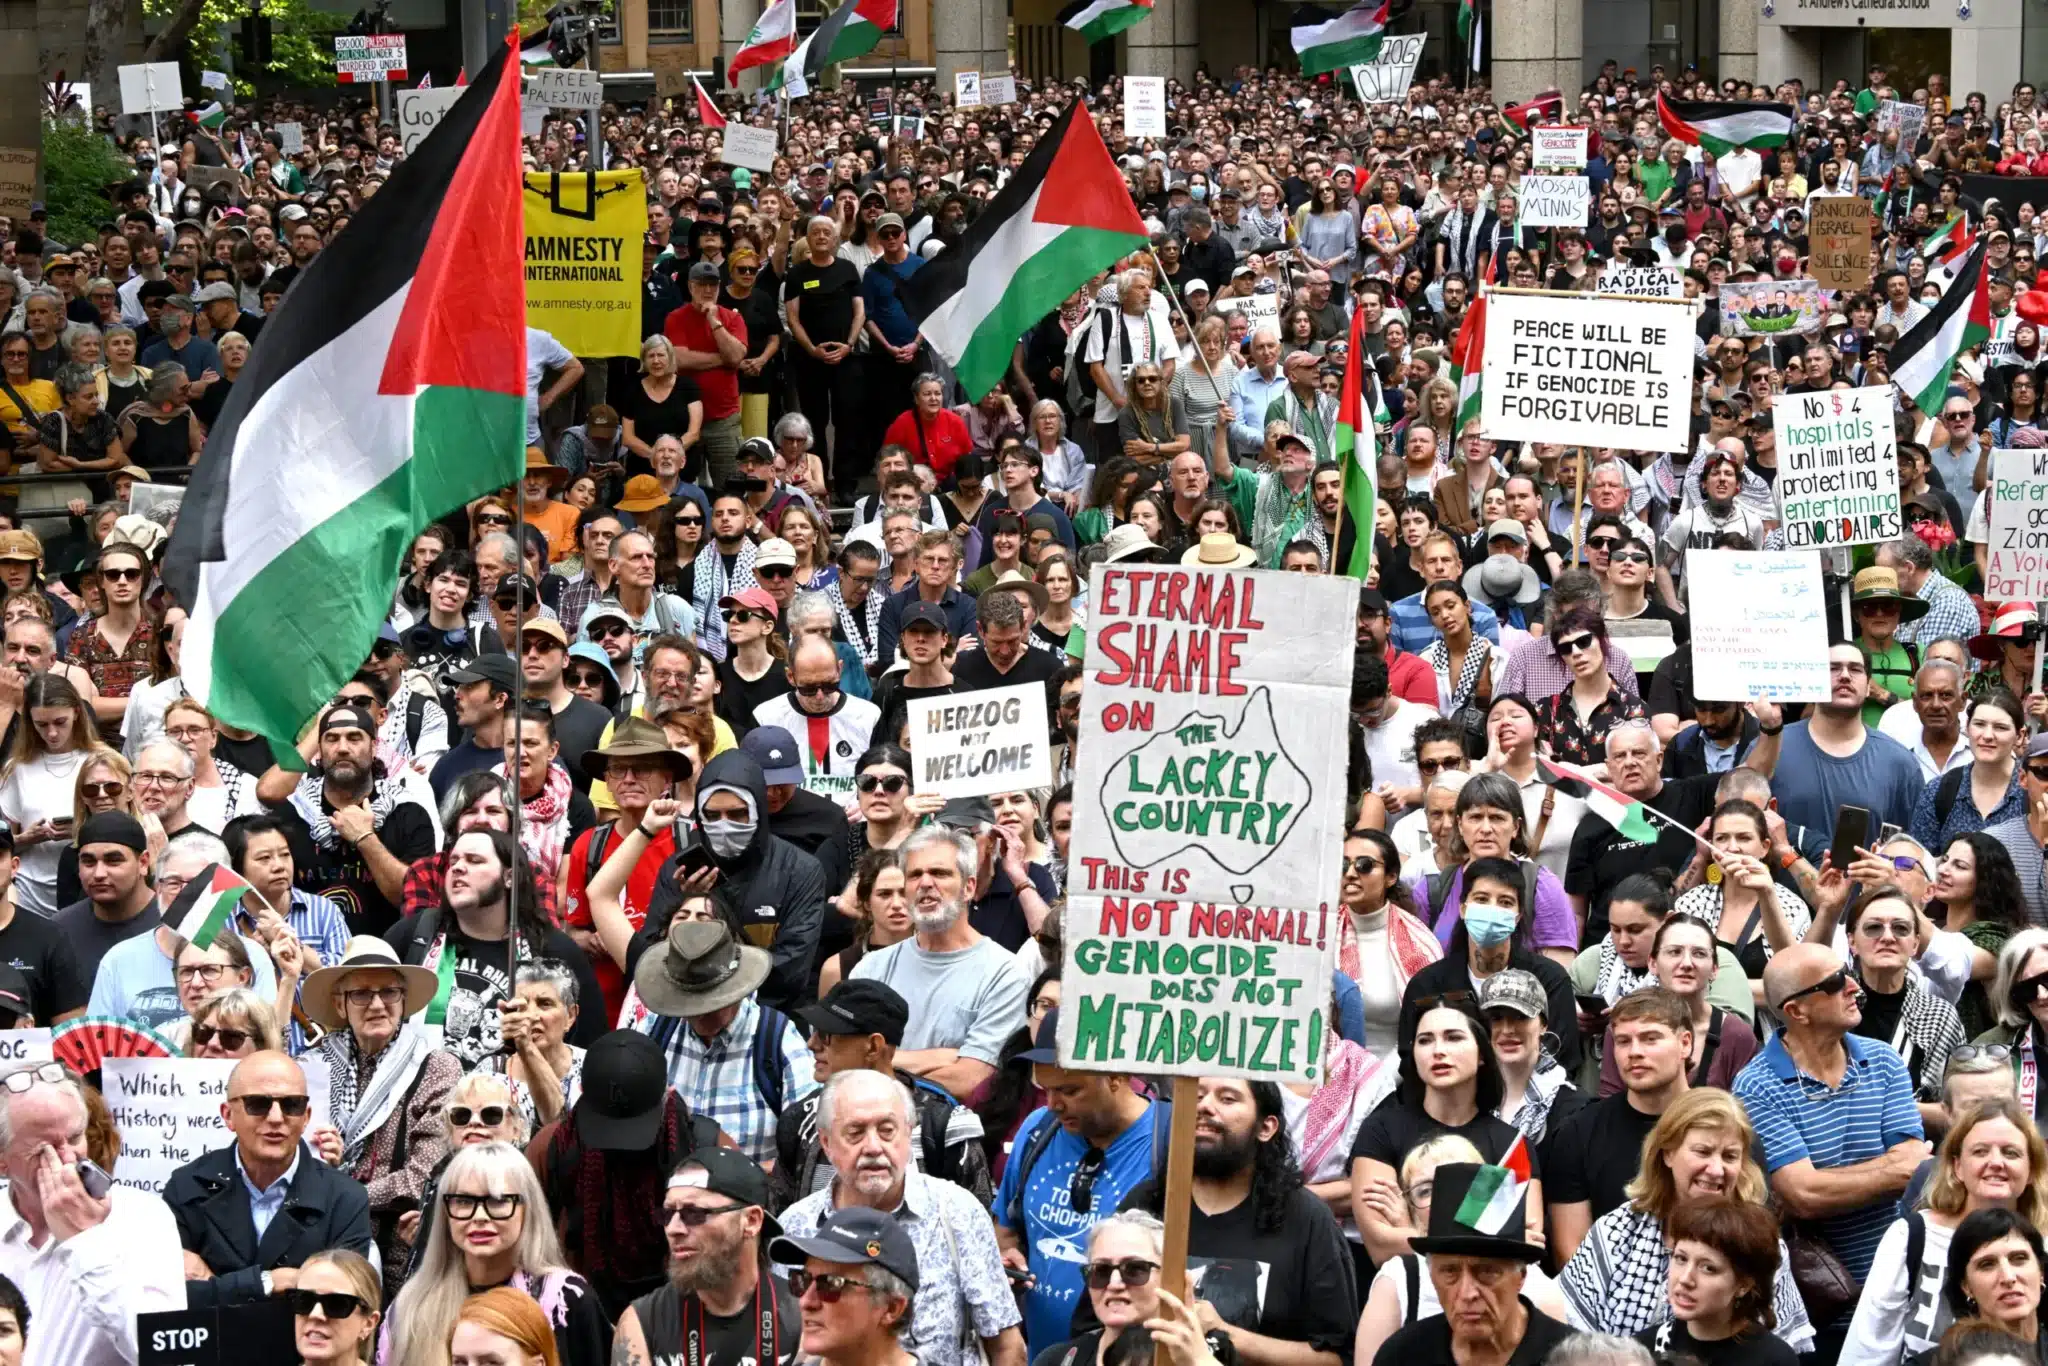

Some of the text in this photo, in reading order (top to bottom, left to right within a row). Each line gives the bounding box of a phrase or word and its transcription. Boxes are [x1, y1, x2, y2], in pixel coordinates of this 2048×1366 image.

[339, 60, 403, 72] MURDERED UNDER
[370, 48, 393, 59] UNDER
[397, 48, 403, 57] 5
[354, 71, 386, 82] HERZOG
[543, 73, 588, 87] FREE
[1358, 66, 1412, 101] OUT
[529, 88, 600, 105] PALESTINE
[1542, 140, 1577, 149] GENOCIDE
[1523, 178, 1588, 198] MOSSAD
[1521, 198, 1583, 220] MINNS
[1813, 203, 1869, 217] SANCTION
[1817, 220, 1862, 236] ISRAEL
[525, 236, 624, 261] AMNESTY
[1827, 236, 1853, 249] NOT
[524, 266, 624, 281] INTERNATIONAL
[1814, 253, 1869, 269] SILENCE
[1599, 273, 1679, 289] RADICAL
[1831, 270, 1852, 282] US
[1625, 287, 1669, 296] OPPOSE
[1236, 300, 1256, 309] WAR
[1513, 319, 1666, 345] PEACE WILL BE
[1514, 344, 1662, 374] FICTIONAL
[1505, 372, 1668, 399] IF GENOCIDE IS
[1502, 395, 1668, 428] FORGIVABLE
[1803, 393, 1861, 419] No $ 4
[1787, 418, 1873, 446] hospitals
[1790, 441, 1893, 470] unlimited 4
[1783, 470, 1877, 499] protecting
[1785, 493, 1898, 520] entertaining
[1787, 512, 1900, 547] GENOCIDAIRES
[1990, 551, 2001, 572] A
[1100, 570, 1265, 631] ETERNAL
[1095, 621, 1248, 696] SHAME
[927, 697, 1021, 734] HERZOG
[1102, 700, 1155, 733] ON
[960, 732, 990, 747] NOT
[1175, 724, 1217, 746] THE
[926, 743, 1033, 782] WELCOME
[1128, 749, 1277, 801] LACKEY
[1113, 800, 1292, 845] COUNTRY
[1162, 868, 1190, 894] IS
[1099, 895, 1179, 937] NOT
[1074, 939, 1278, 977] GENOCIDE
[1150, 978, 1302, 1006] DOES NOT
[119, 1073, 185, 1097] Which
[113, 1108, 226, 1140] History were
[160, 1144, 189, 1162] the
[1051, 1187, 1071, 1206] TO
[152, 1327, 209, 1351] STOP
[762, 1311, 773, 1357] EOS 7D
